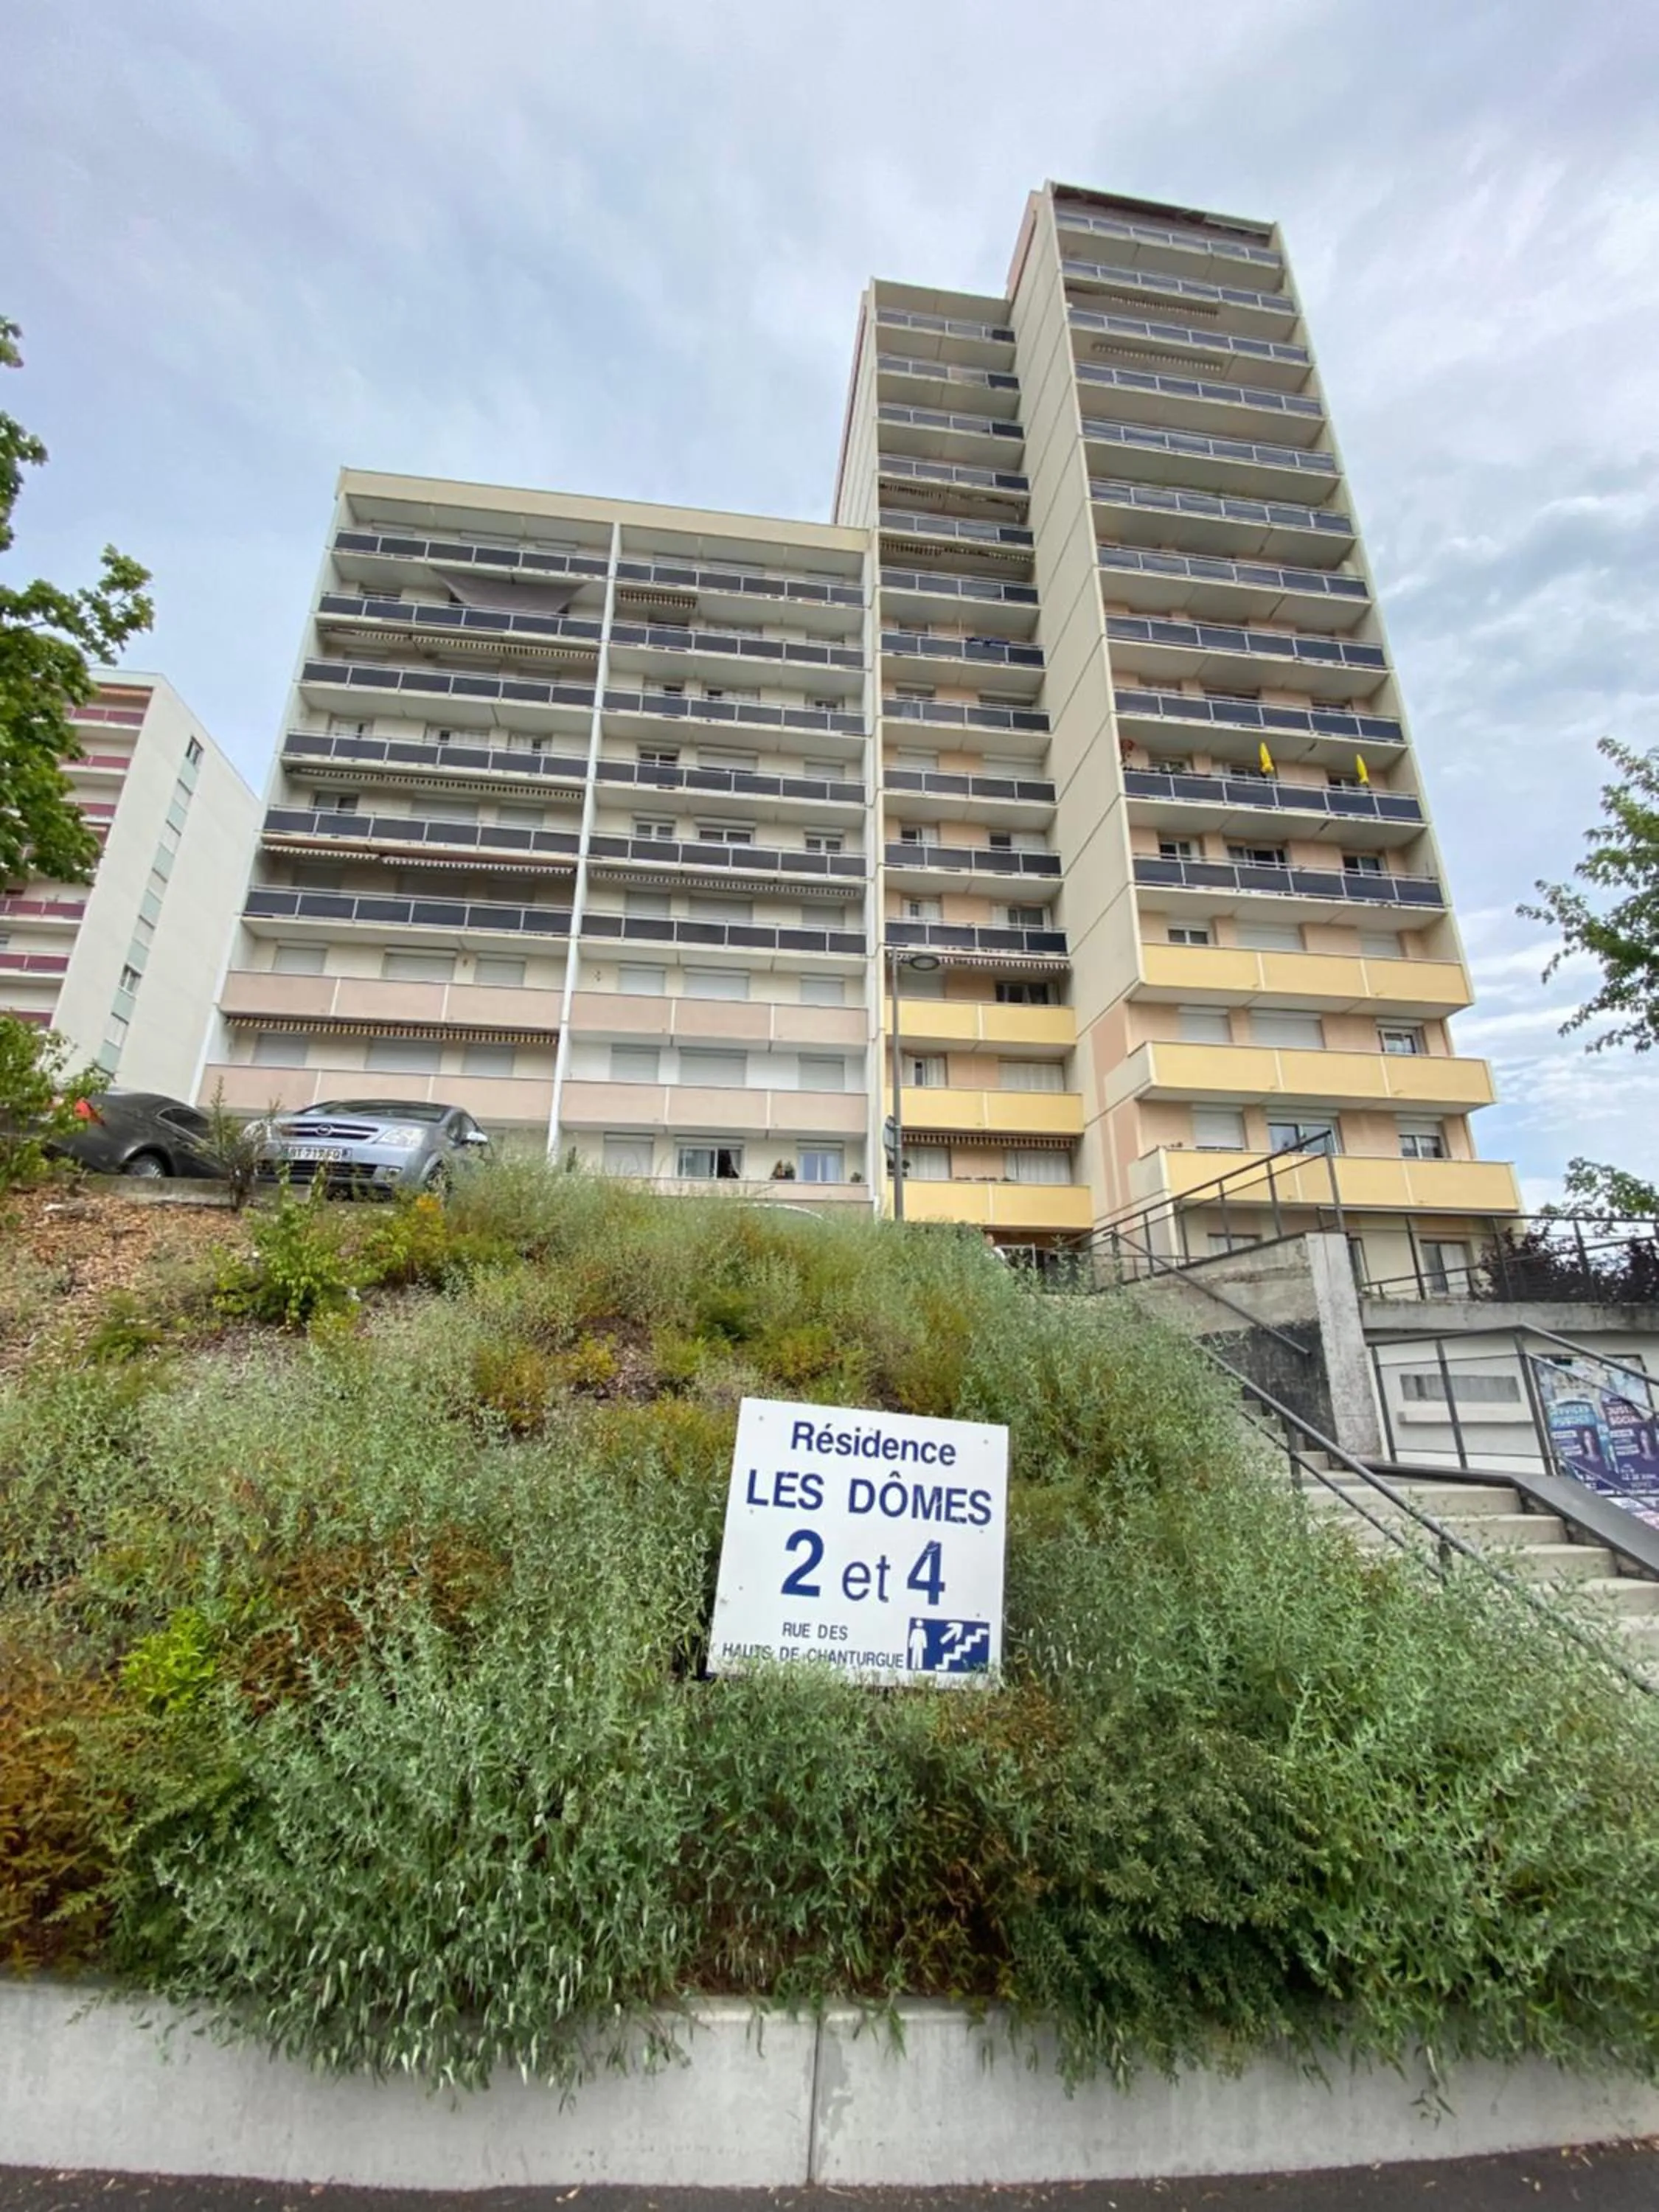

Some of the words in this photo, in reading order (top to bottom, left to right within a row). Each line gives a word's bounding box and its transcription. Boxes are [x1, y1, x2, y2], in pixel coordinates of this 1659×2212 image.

[790, 1421, 956, 1465] Résidence
[746, 1469, 824, 1510] LES
[848, 1471, 992, 1526] DÔMES
[781, 1529, 824, 1597] 2
[842, 1555, 890, 1602] et
[907, 1540, 945, 1605] 4
[782, 1621, 810, 1638] RUE
[818, 1624, 848, 1640] DES
[723, 1643, 772, 1660] HAUTS
[780, 1646, 799, 1660] DE
[807, 1648, 904, 1668] CHANTURGUE
